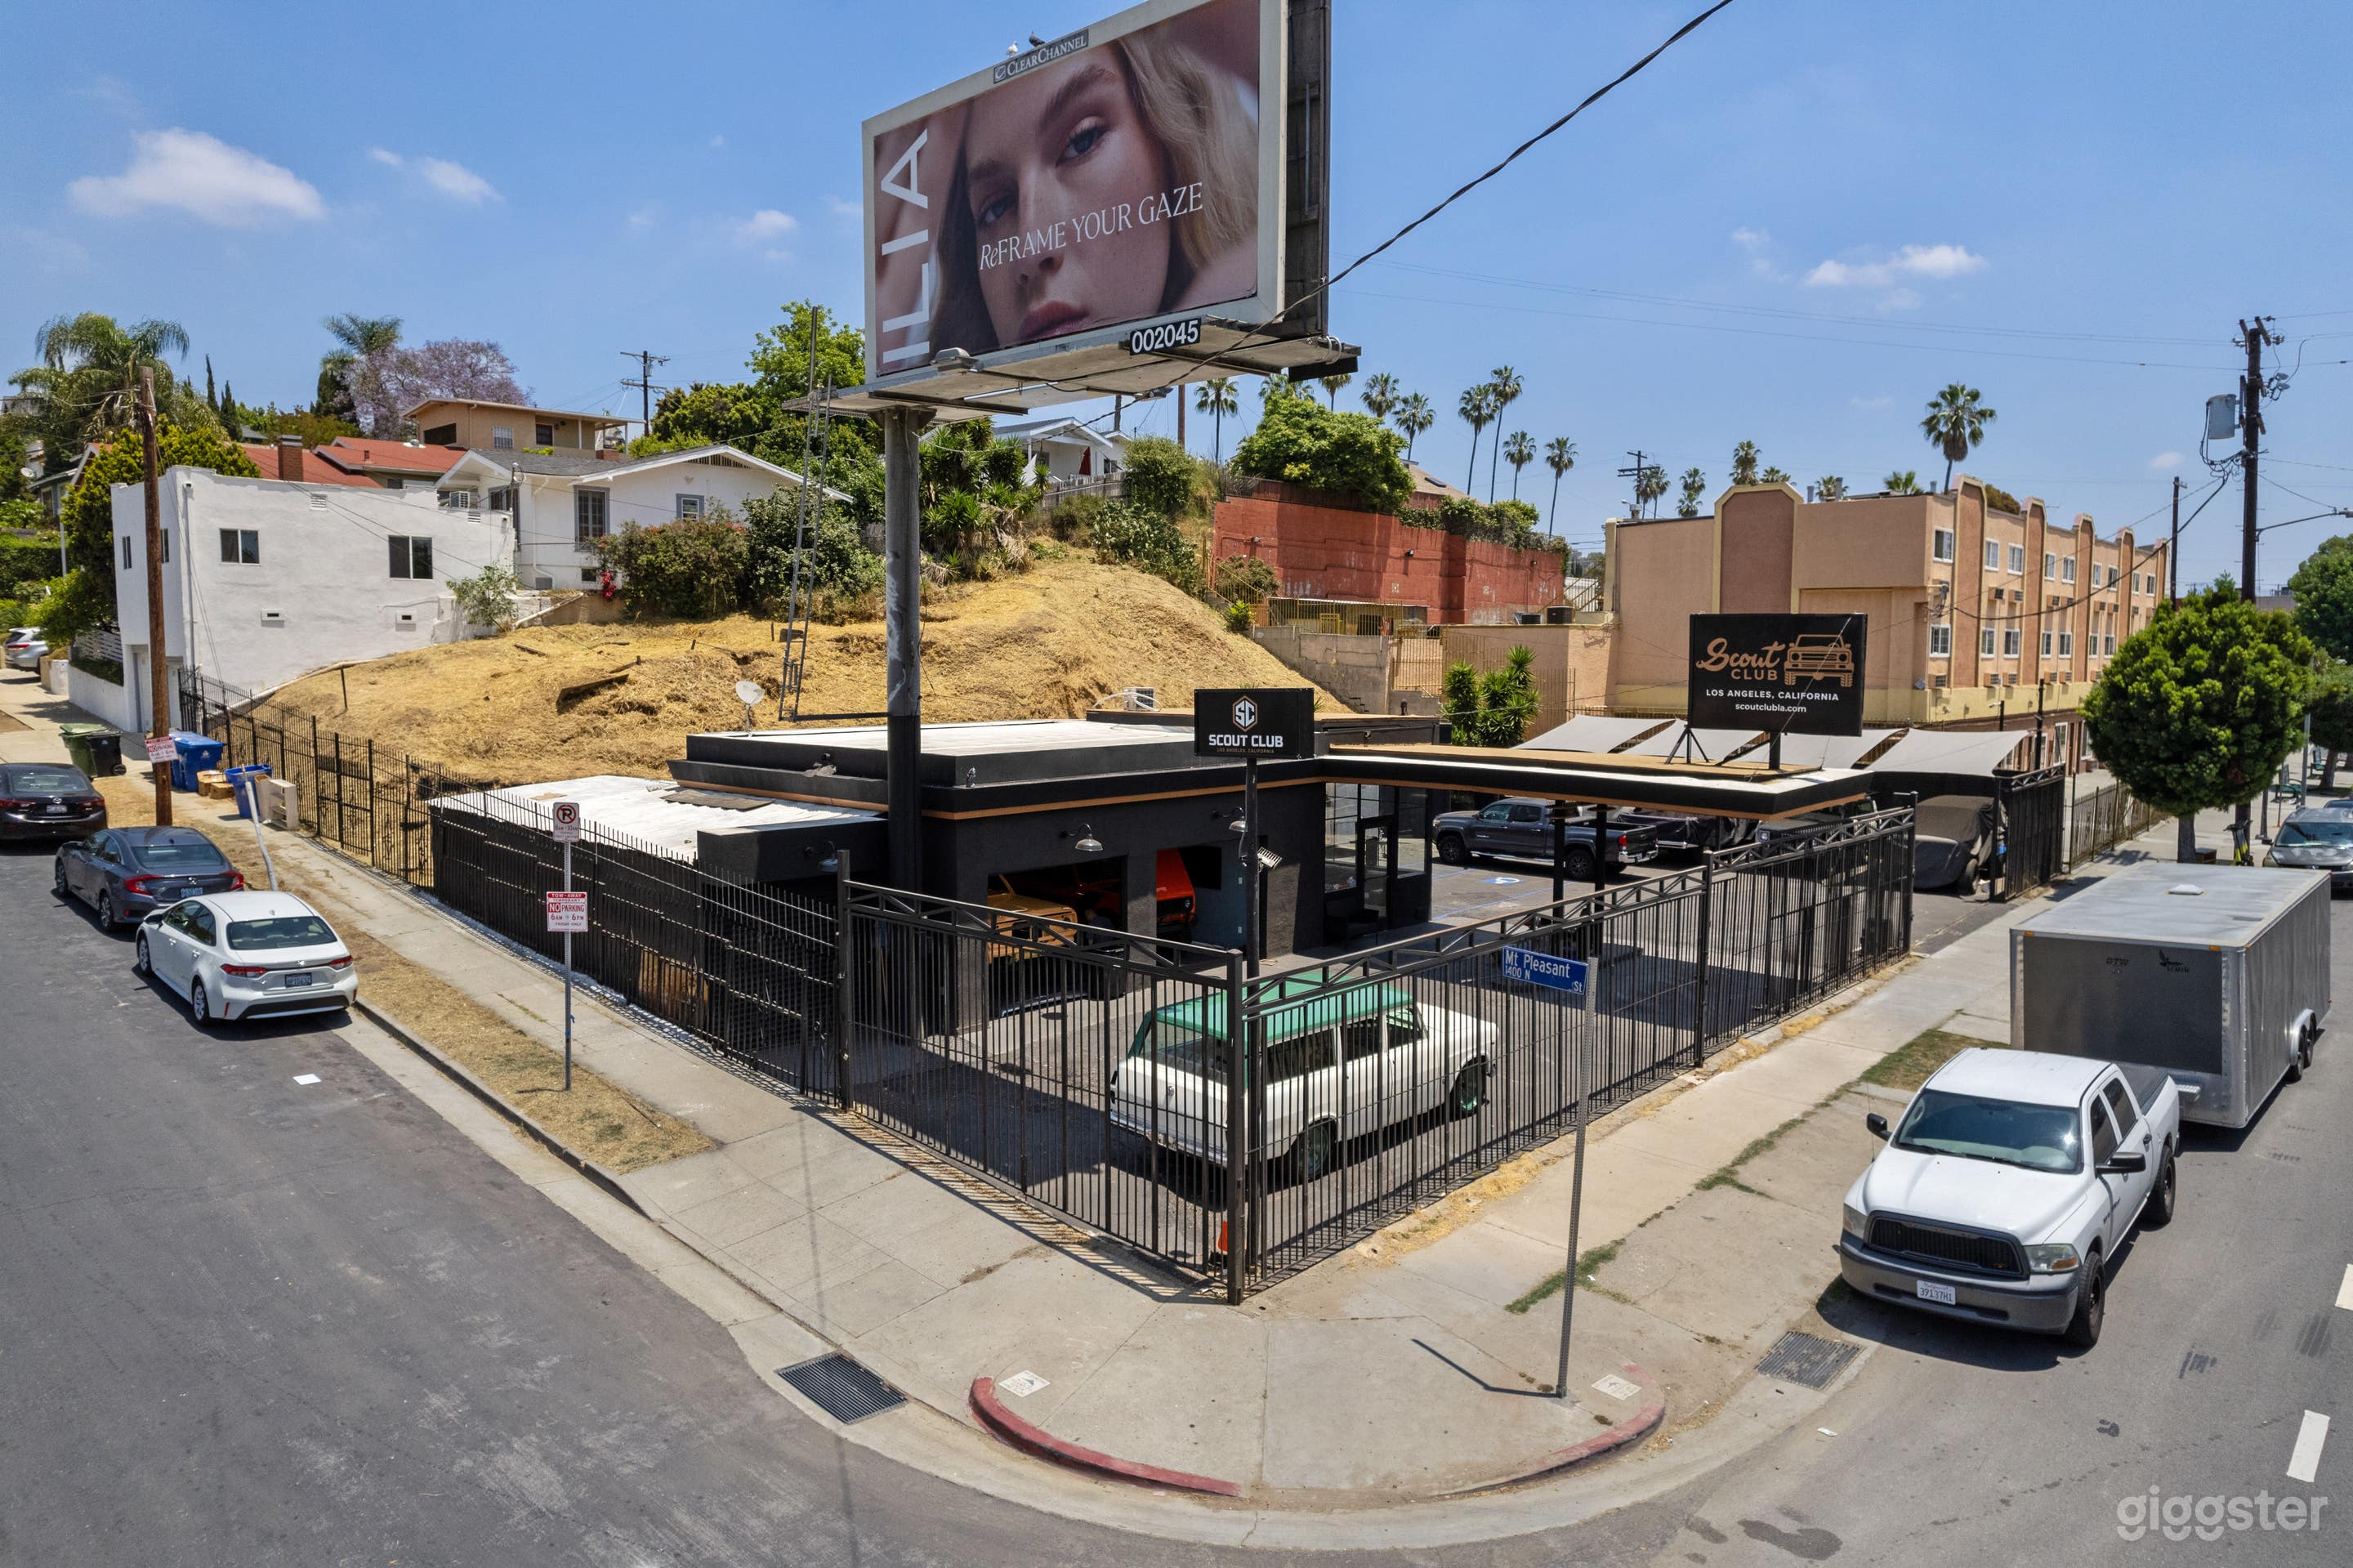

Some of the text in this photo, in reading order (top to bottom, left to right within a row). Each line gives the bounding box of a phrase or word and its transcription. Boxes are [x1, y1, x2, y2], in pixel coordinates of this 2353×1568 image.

[980, 182, 1203, 270] ReFRAME YOUR GAZE
[881, 128, 928, 364] ILIA
[1132, 319, 1199, 354] 002045
[1696, 637, 1785, 672] Scout
[1731, 668, 1778, 681] CLUB
[1706, 689, 1839, 701] LOS ANGELES, CALIFORNIA
[1235, 699, 1255, 727] SC
[1735, 703, 1806, 713] scoutclubla.com
[1208, 734, 1284, 748] SCOUT CLUB
[549, 903, 585, 913] NO PARKING
[1506, 949, 1570, 979] Mt Pleasant
[1505, 965, 1530, 980] 1400 N
[1574, 981, 1583, 993] St
